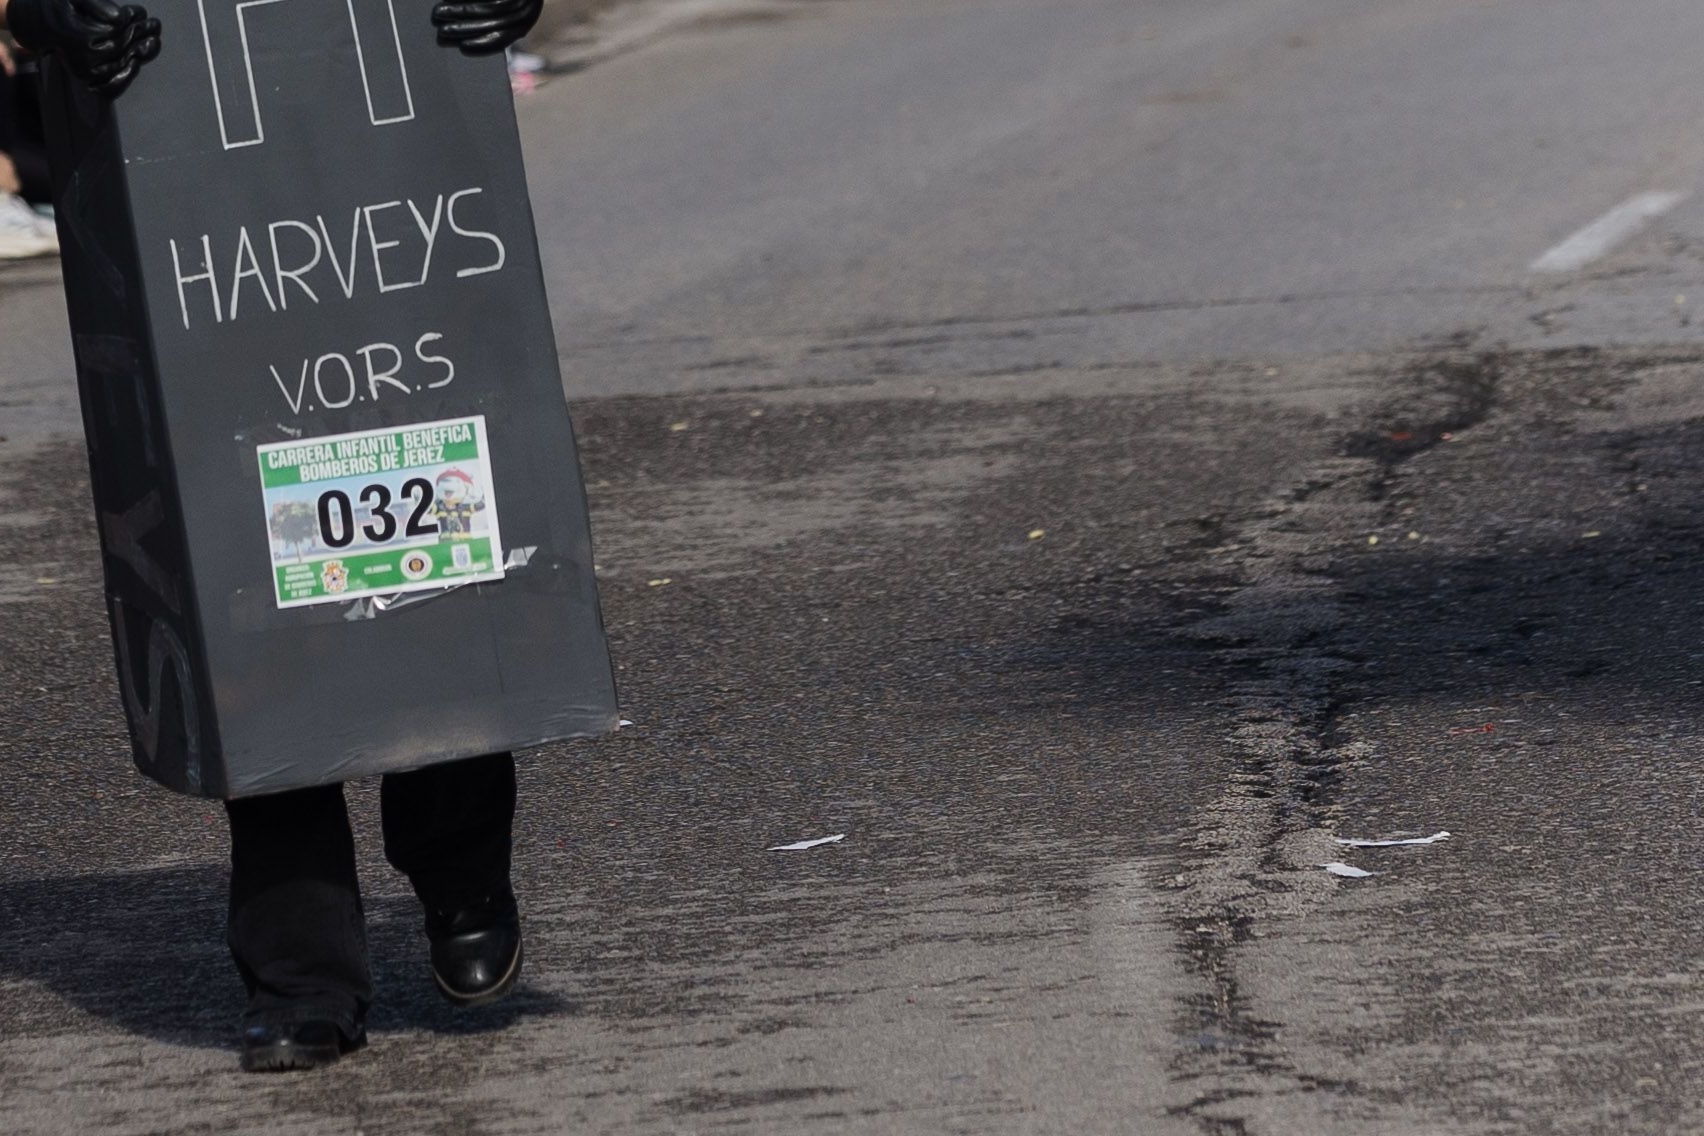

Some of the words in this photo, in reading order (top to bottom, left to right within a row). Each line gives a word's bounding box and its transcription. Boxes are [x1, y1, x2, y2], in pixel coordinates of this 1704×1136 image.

[169, 187, 505, 330] HARVEYS
[267, 443, 334, 470] CARRERA
[337, 433, 401, 461] INFANTIL
[299, 457, 378, 483] BOMBEROS
[381, 450, 399, 471] DE
[403, 445, 445, 468] JEREZ
[317, 477, 439, 548] 032
